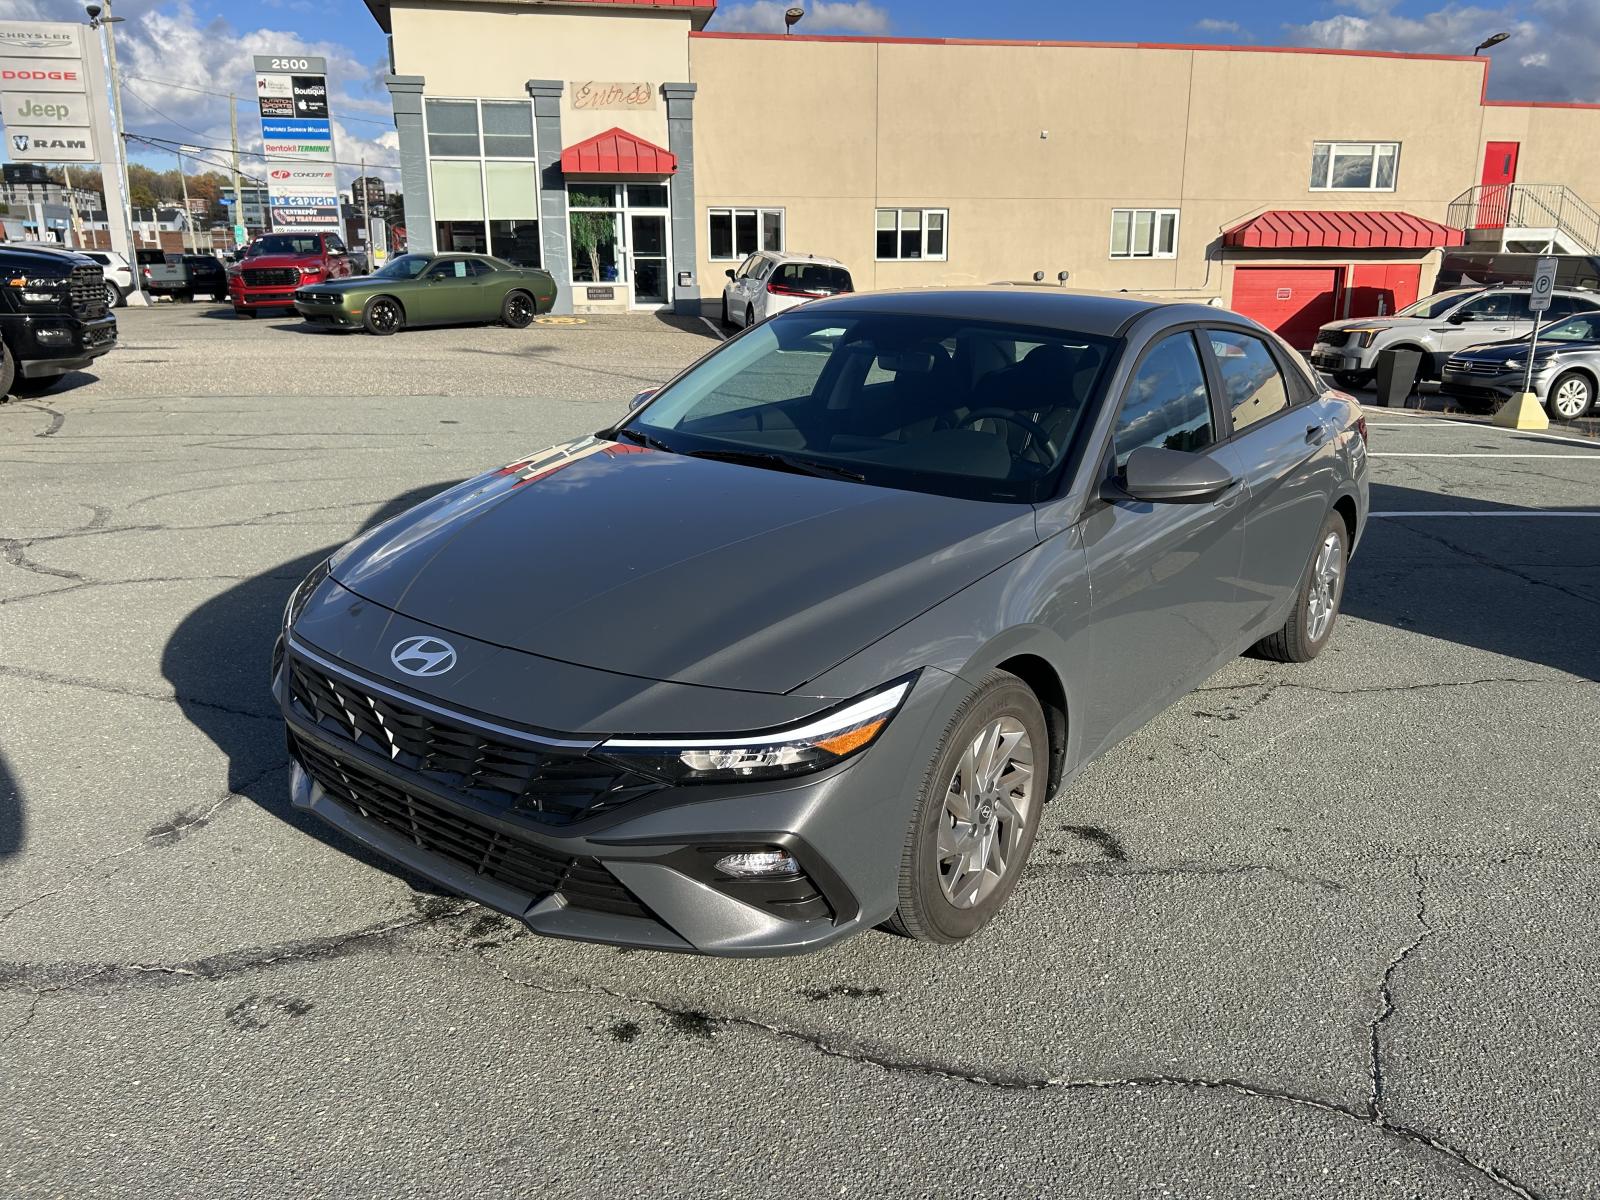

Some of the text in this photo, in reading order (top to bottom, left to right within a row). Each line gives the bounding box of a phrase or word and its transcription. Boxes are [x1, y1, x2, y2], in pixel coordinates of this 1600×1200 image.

[271, 59, 308, 69] 2500
[2, 71, 77, 80] DODGE
[294, 87, 325, 96] Boutique
[18, 100, 69, 121] Jeep
[33, 139, 86, 149] RAM
[265, 144, 330, 153] Rentokil TERMINIX
